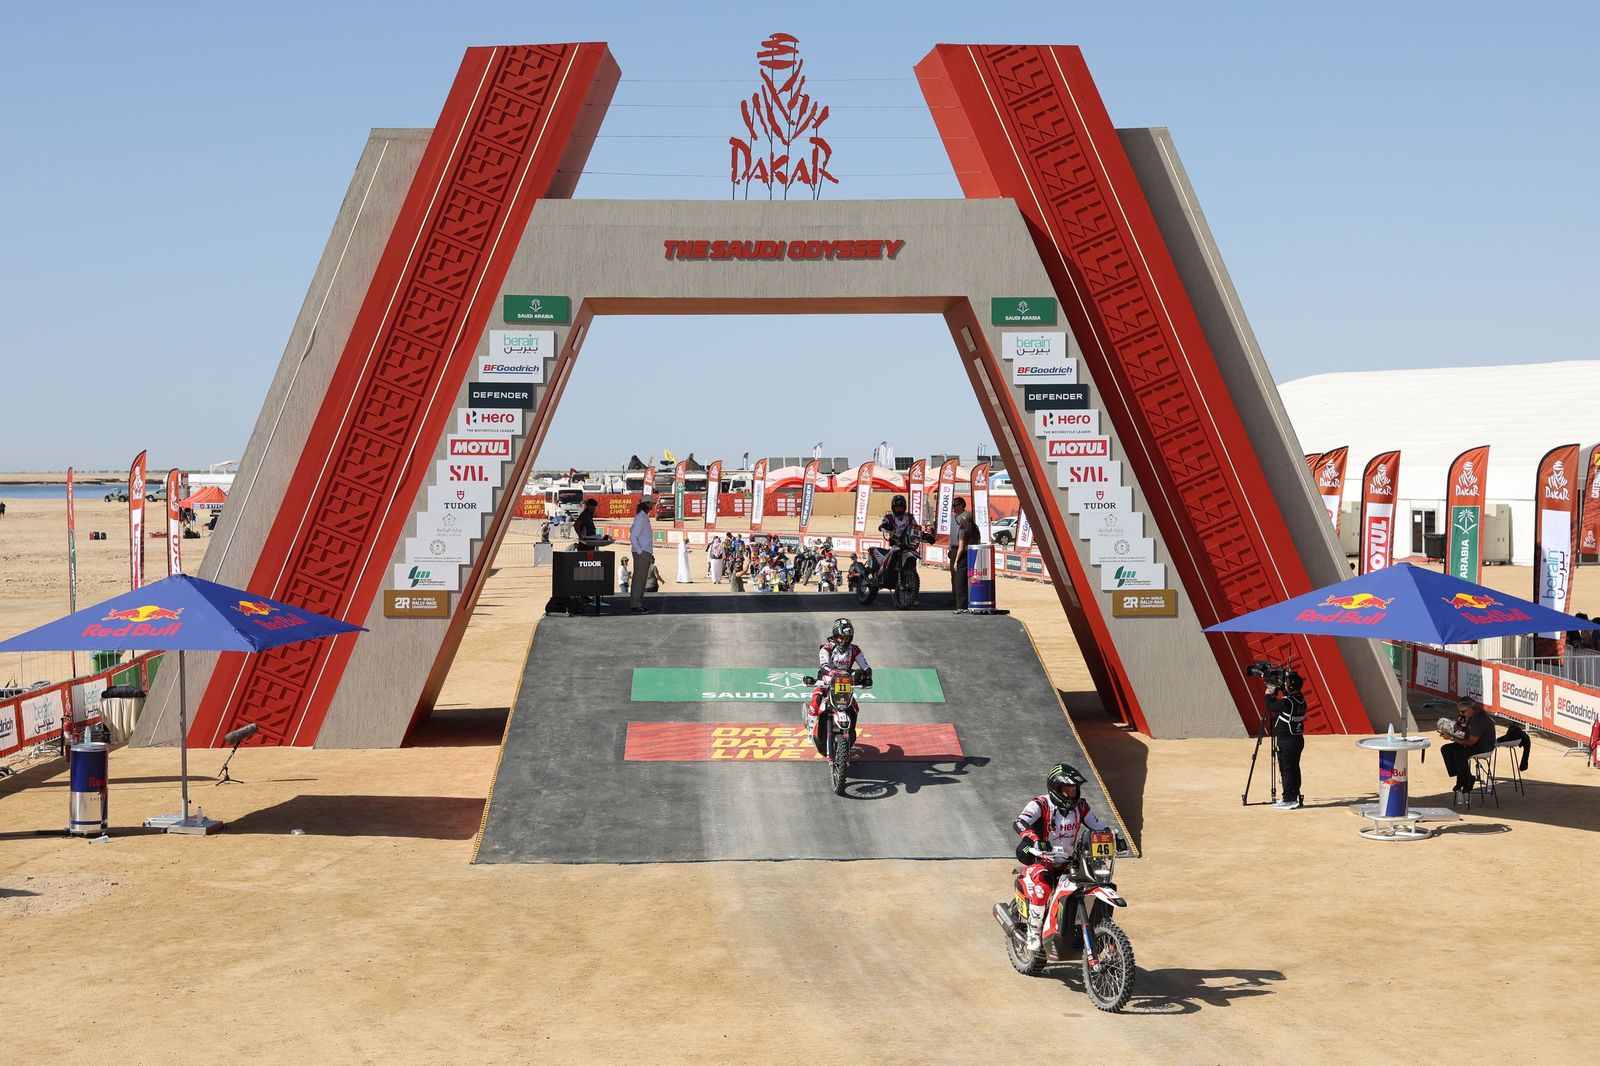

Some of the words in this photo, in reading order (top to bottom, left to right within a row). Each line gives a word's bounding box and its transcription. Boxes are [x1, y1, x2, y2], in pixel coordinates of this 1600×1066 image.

[729, 137, 839, 185] DAKAR
[664, 239, 711, 260] THE
[709, 239, 786, 260] SAUDI
[786, 239, 905, 260] ODYSSEY
[503, 334, 539, 346] berain
[1016, 336, 1051, 348] berain
[503, 346, 538, 354] بيرين
[1016, 348, 1050, 356] بيرين
[483, 364, 540, 372] BFGoodrich
[1017, 366, 1073, 374] BFGoodrich
[473, 391, 528, 399] DEFENDER
[481, 413, 514, 423] Hero
[1058, 415, 1091, 424] Hero
[453, 441, 507, 454] MOTUL
[1052, 442, 1105, 454] MOTUL
[1319, 478, 1341, 488] DAKAR
[1370, 483, 1393, 495] DAKAR
[1456, 484, 1480, 496] DAKAR
[1545, 486, 1570, 501] DAKAR
[859, 492, 867, 514] Hero
[941, 494, 950, 524] TUDOR
[1370, 520, 1387, 571] OTUL
[1460, 539, 1469, 579] ARABIA
[1542, 550, 1559, 600] berain
[1295, 609, 1343, 623] Red
[1338, 612, 1388, 625] Bull
[1494, 608, 1532, 621] Bull
[82, 623, 134, 637] Red
[131, 622, 183, 637] Bull
[838, 684, 847, 692] 11
[1502, 681, 1538, 702] BFGoodrich
[1557, 697, 1598, 720] BFGoodrich
[710, 748, 807, 759] LIVE
[1097, 844, 1110, 855] 46
